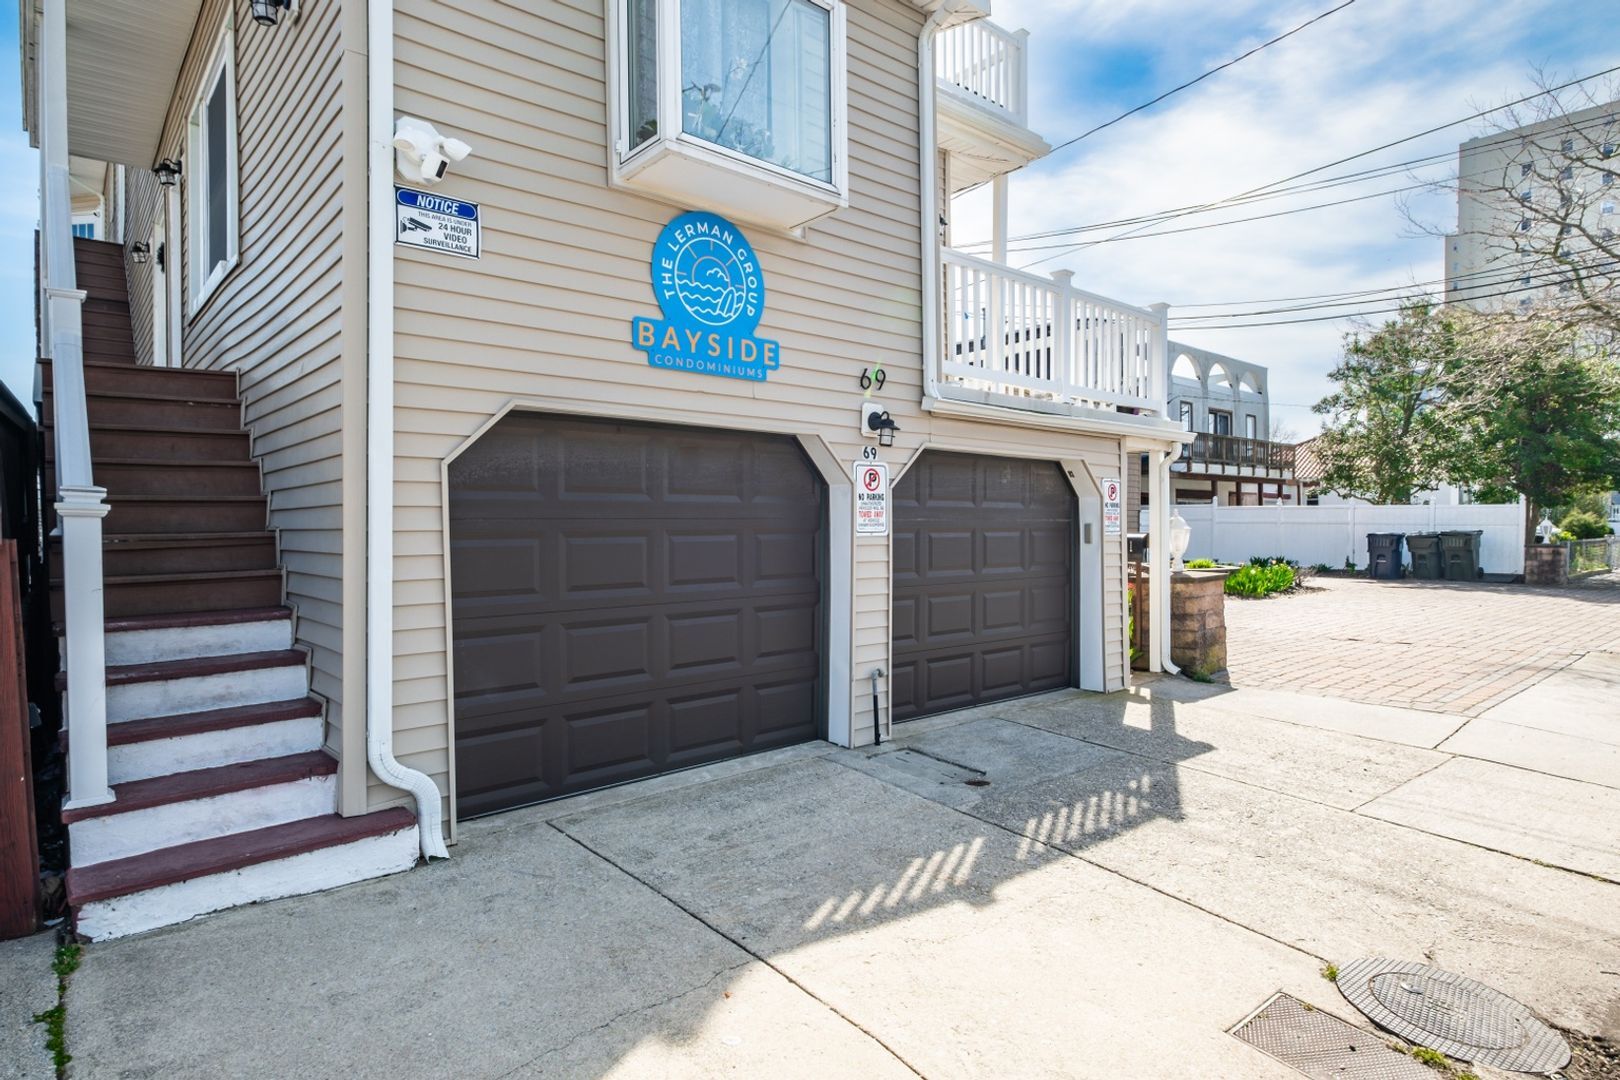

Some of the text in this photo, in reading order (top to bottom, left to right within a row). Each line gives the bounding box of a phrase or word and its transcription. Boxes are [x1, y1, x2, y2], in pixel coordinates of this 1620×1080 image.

[416, 194, 460, 215] NOTICE
[418, 211, 431, 219] THIS
[431, 214, 446, 222] AREA
[453, 219, 472, 227] UNDER
[438, 222, 472, 236] 24 HOUR
[423, 237, 472, 253] SURVEILLANCE
[443, 232, 468, 244] VIDEO
[661, 222, 758, 316] THE LERMAN GROUP
[638, 321, 776, 366] BAYSIDE
[654, 354, 763, 379] CONDOMINIUMS
[860, 368, 886, 391] 69
[863, 446, 877, 460] 69
[858, 493, 885, 501] NO PARKING
